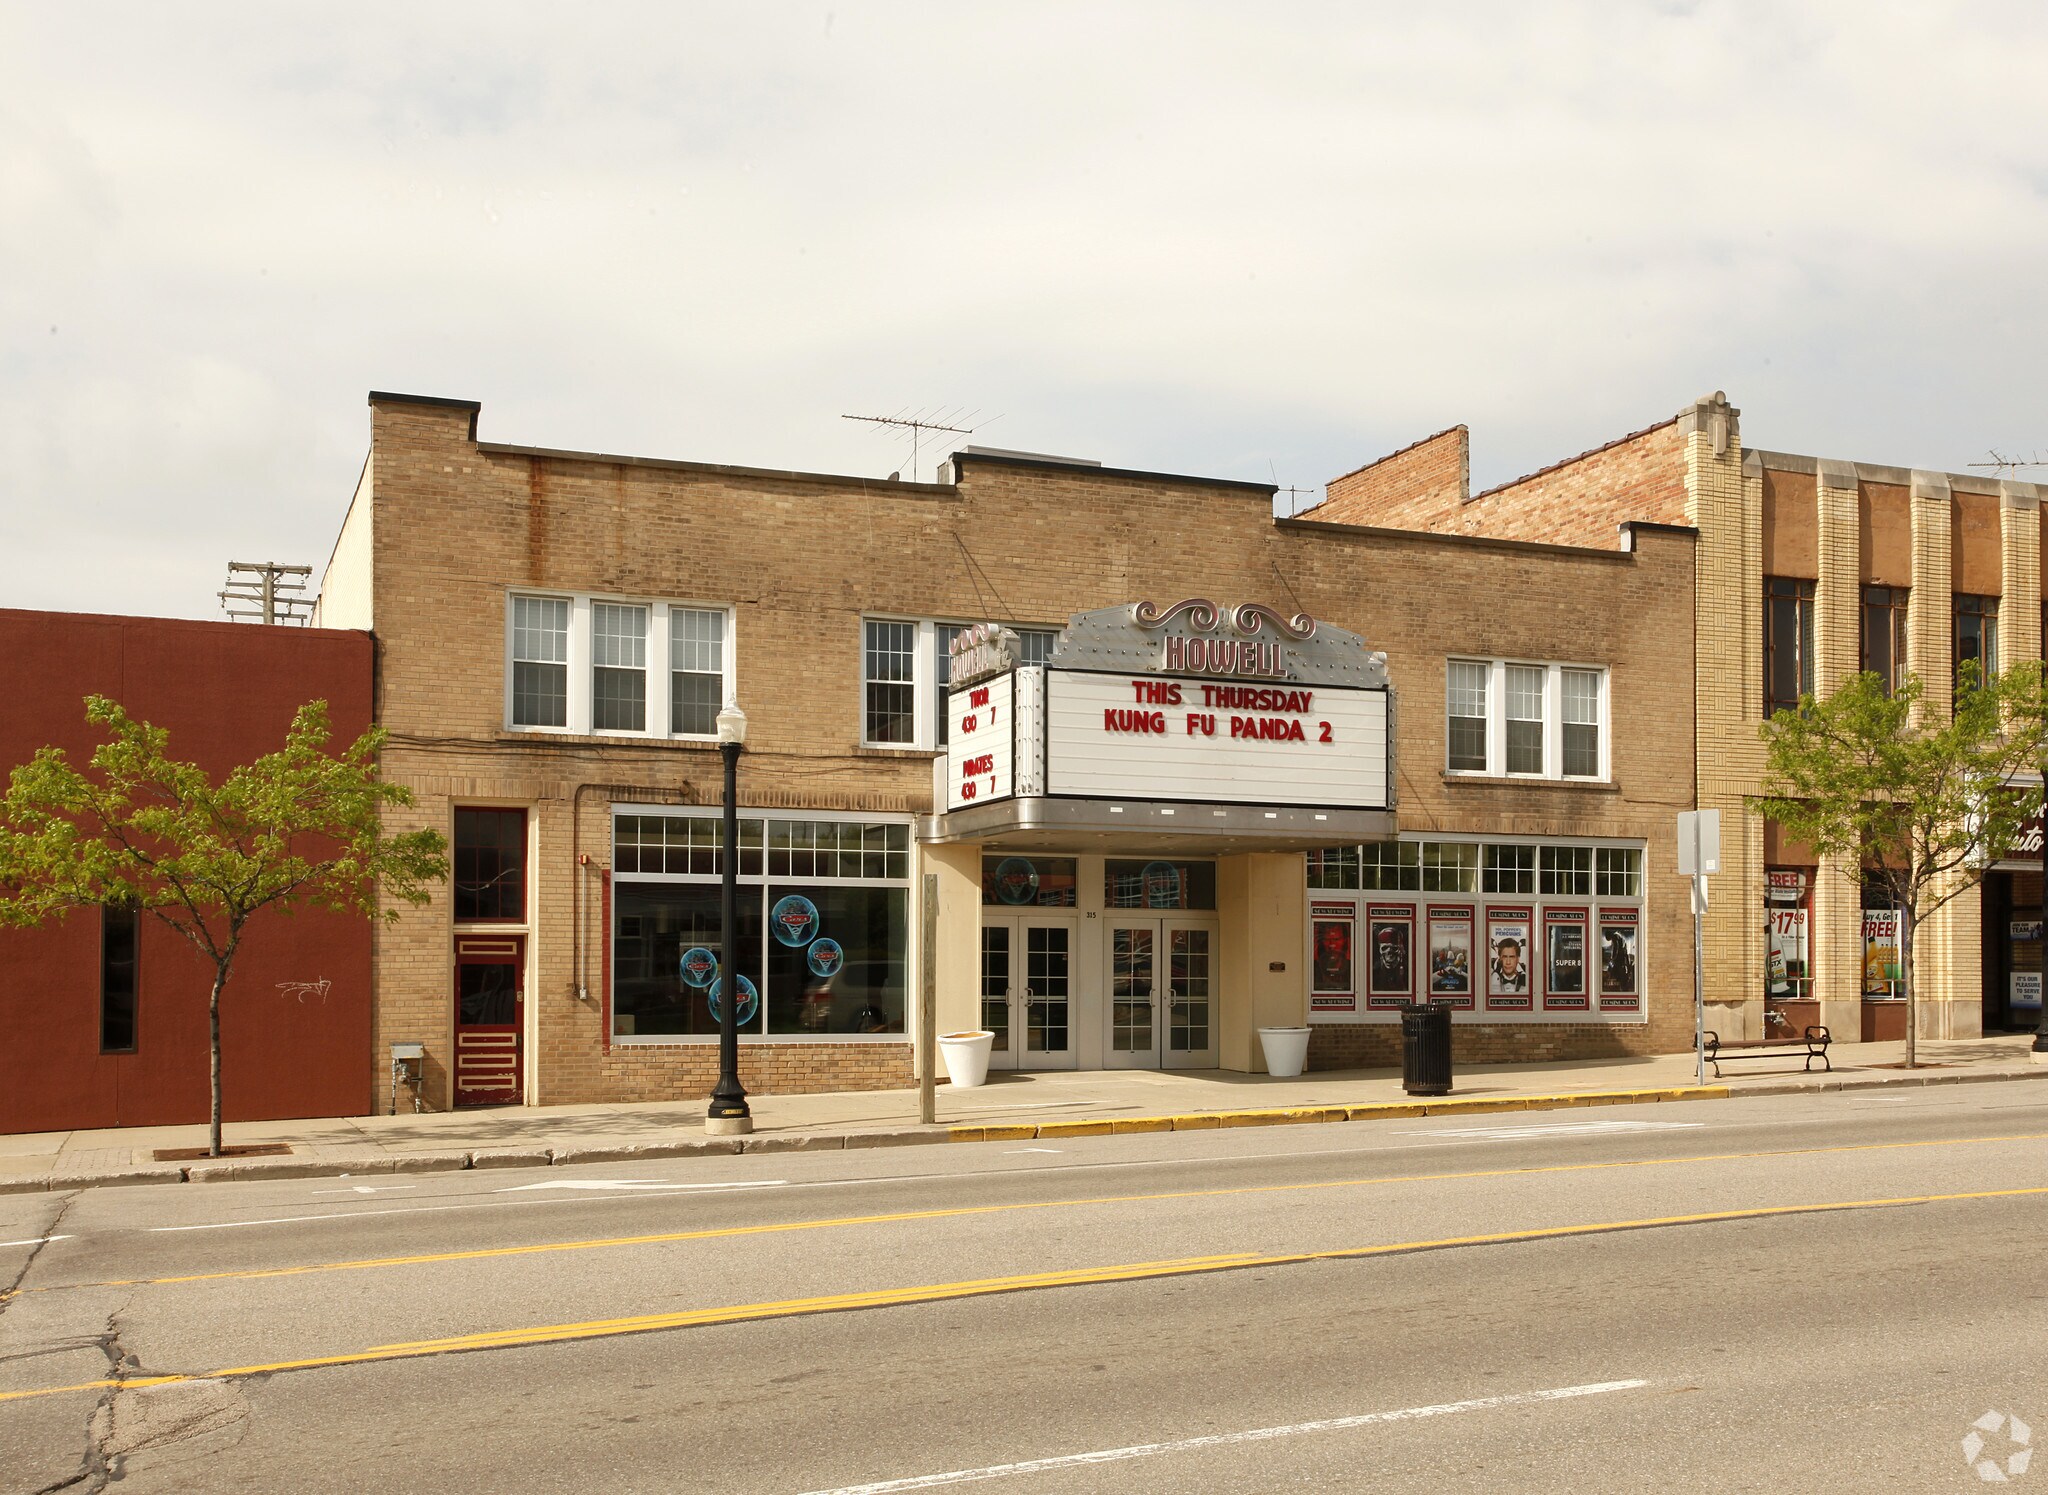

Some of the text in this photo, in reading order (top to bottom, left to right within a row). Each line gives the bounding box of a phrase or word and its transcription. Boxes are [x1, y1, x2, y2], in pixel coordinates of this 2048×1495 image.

[1162, 635, 1288, 678] HOWELL
[969, 687, 990, 709] THOR
[1132, 681, 1313, 713] THIS THURSDAY
[961, 706, 996, 734] 430 7
[1104, 709, 1333, 742] KUNG FU PANDA 2
[962, 754, 994, 778] PIRATES
[961, 775, 996, 801] 430 7
[1086, 911, 1097, 919] 315
[1860, 921, 1898, 937] FREE!
[1555, 959, 1582, 967] SUPER 8
